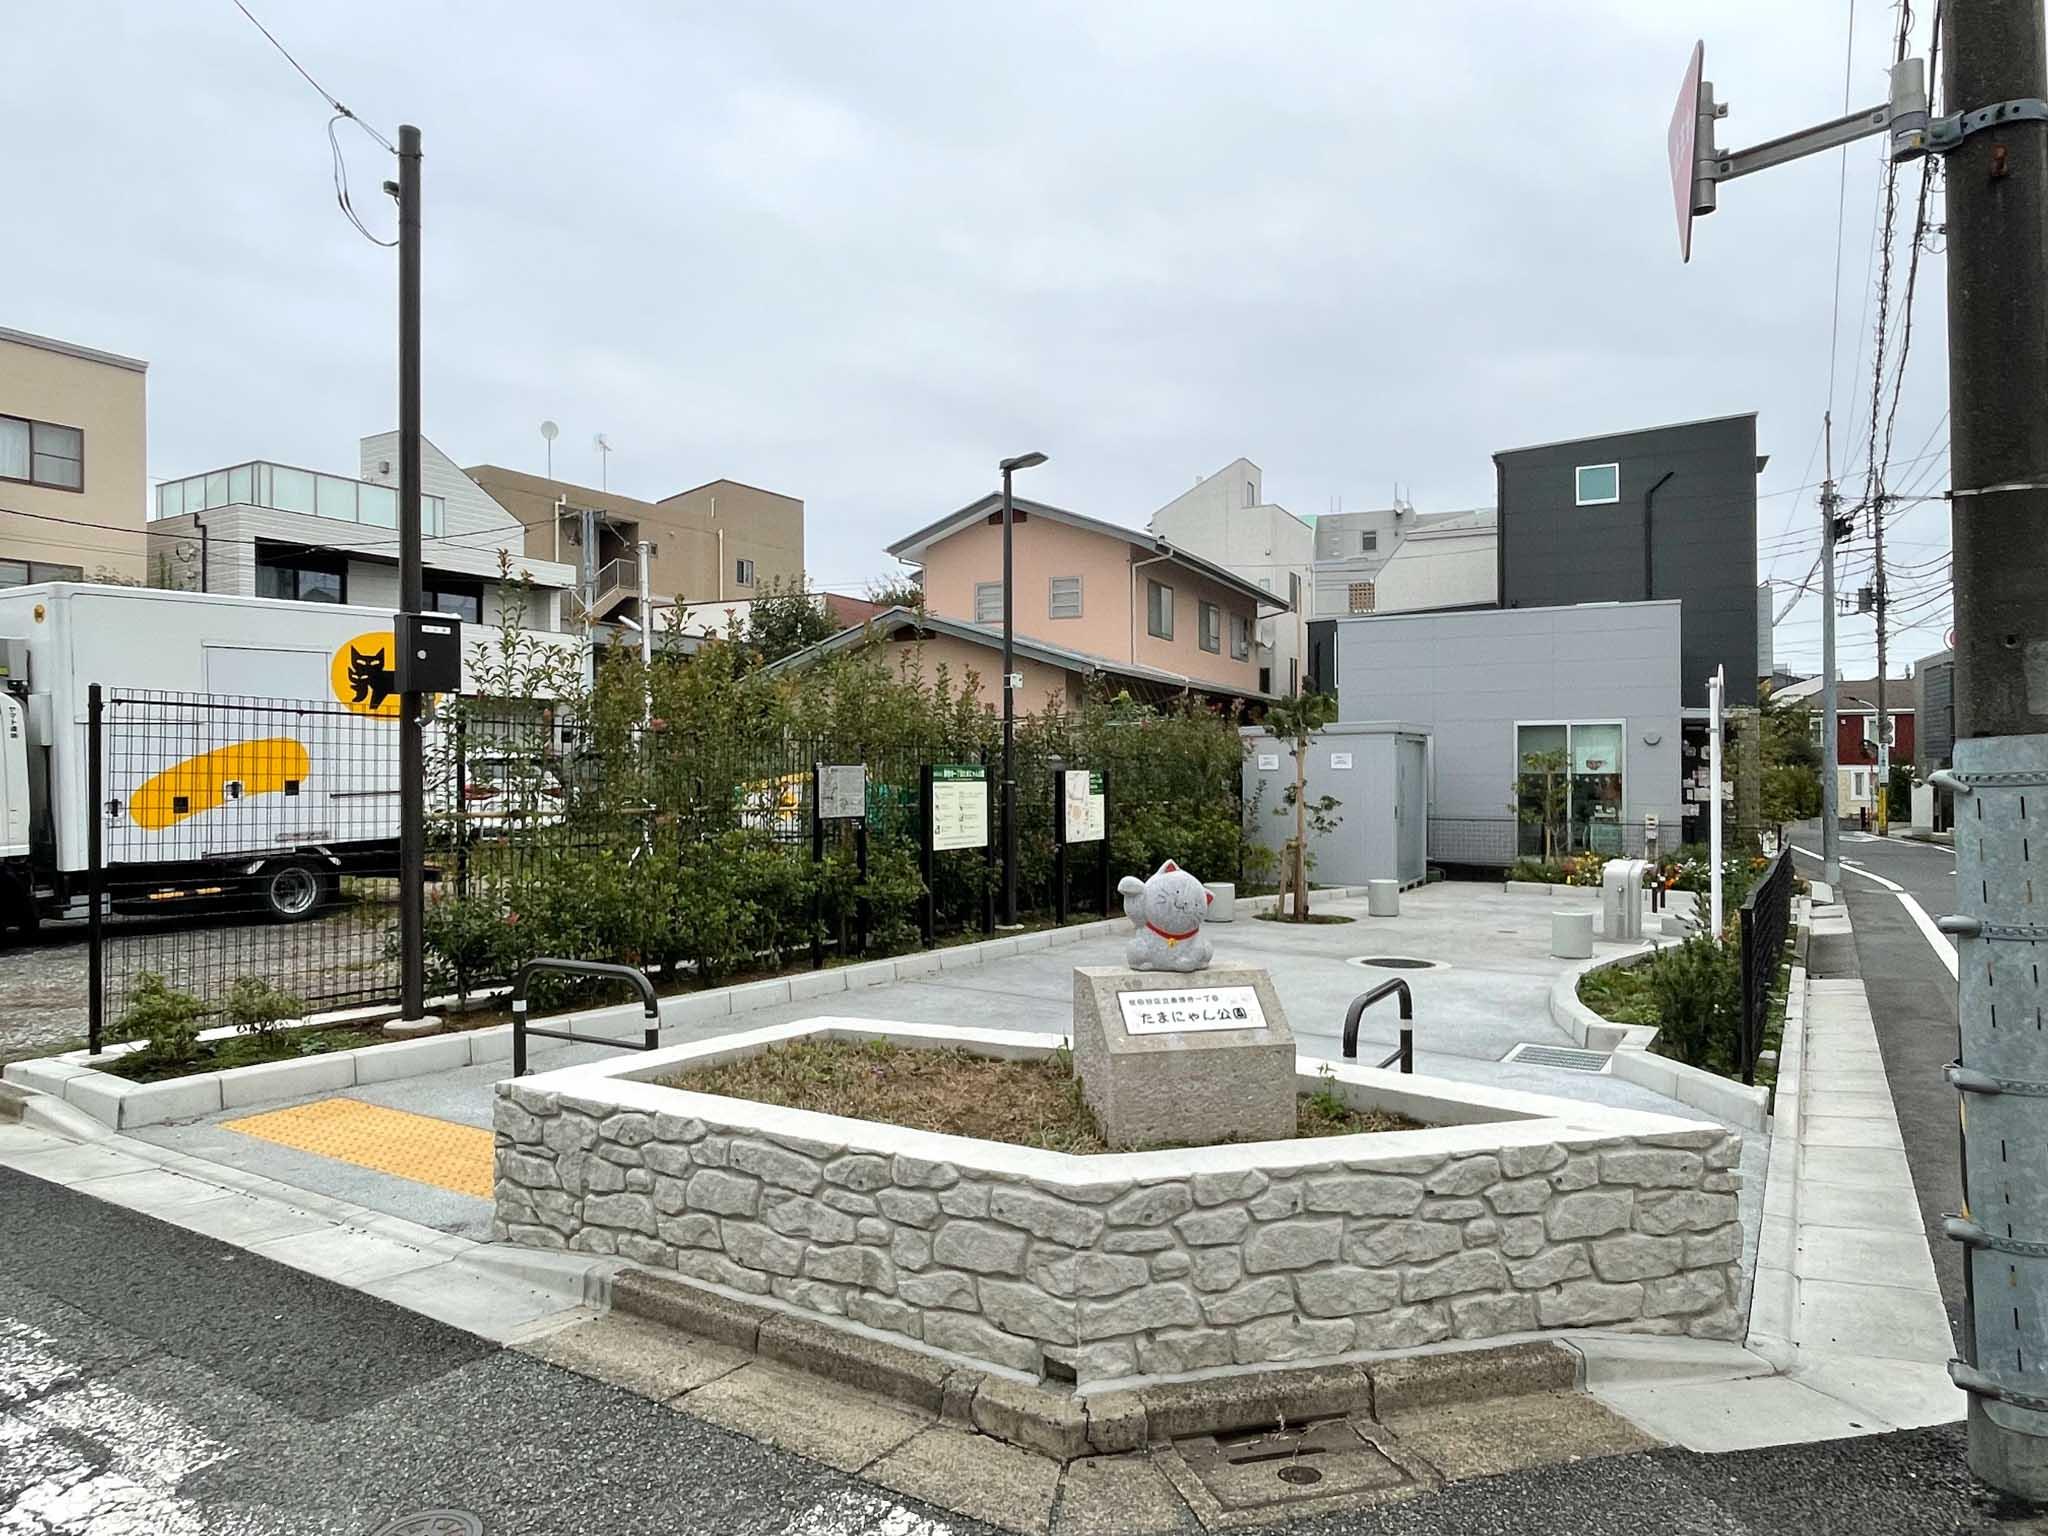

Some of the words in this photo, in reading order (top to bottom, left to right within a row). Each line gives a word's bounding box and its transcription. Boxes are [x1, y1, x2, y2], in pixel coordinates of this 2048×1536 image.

[1141, 1007, 1248, 1025] たまにゃん公園
